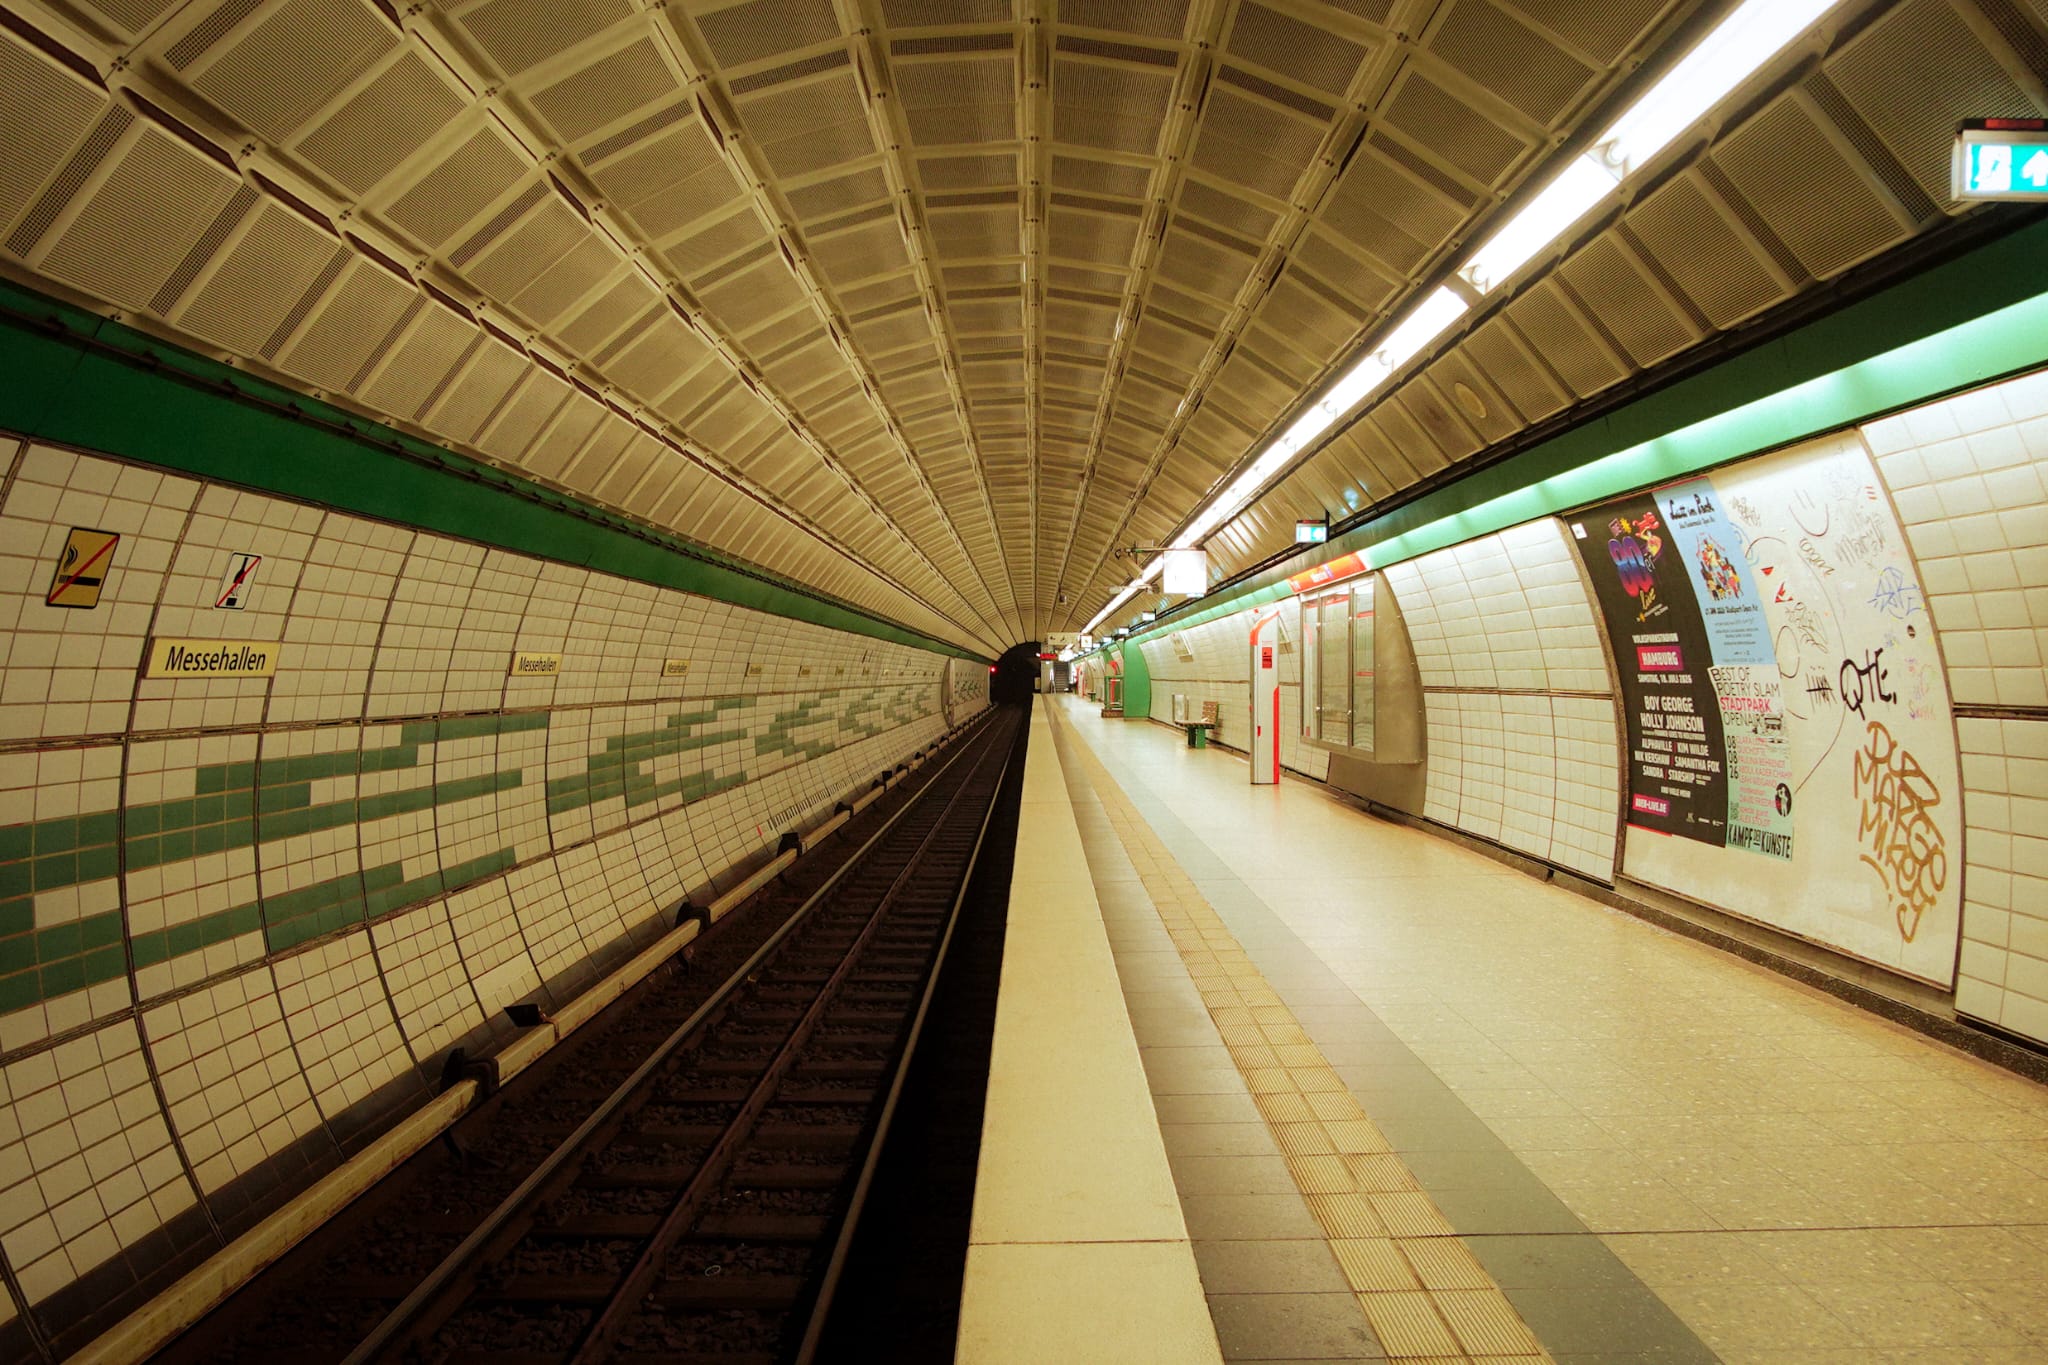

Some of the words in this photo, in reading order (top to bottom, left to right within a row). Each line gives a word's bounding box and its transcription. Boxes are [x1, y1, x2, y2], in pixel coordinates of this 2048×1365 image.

[165, 646, 266, 671] Messehallen
[518, 656, 557, 673] Messehallen
[1641, 651, 1679, 666] HAMBURG
[1710, 667, 1735, 682] BEST
[1738, 667, 1750, 681] OF
[1716, 682, 1751, 697] POETRY
[1754, 682, 1780, 698] SLAM
[1643, 695, 1660, 711] BOY
[1661, 696, 1694, 713] GEORGE
[1720, 697, 1772, 713] STADTPARK
[1640, 712, 1664, 729] HOLLY
[1666, 714, 1704, 732] JOHNSON
[1677, 741, 1689, 754] KIM
[1689, 743, 1709, 757] WILDE
[1726, 735, 1737, 749] 08
[1642, 765, 1664, 779] SANDRA
[1674, 755, 1707, 771] SAMANTHA
[1706, 760, 1720, 773] FOX
[1728, 823, 1753, 849] KAMPF
[1760, 831, 1792, 859] KÜNSTE
